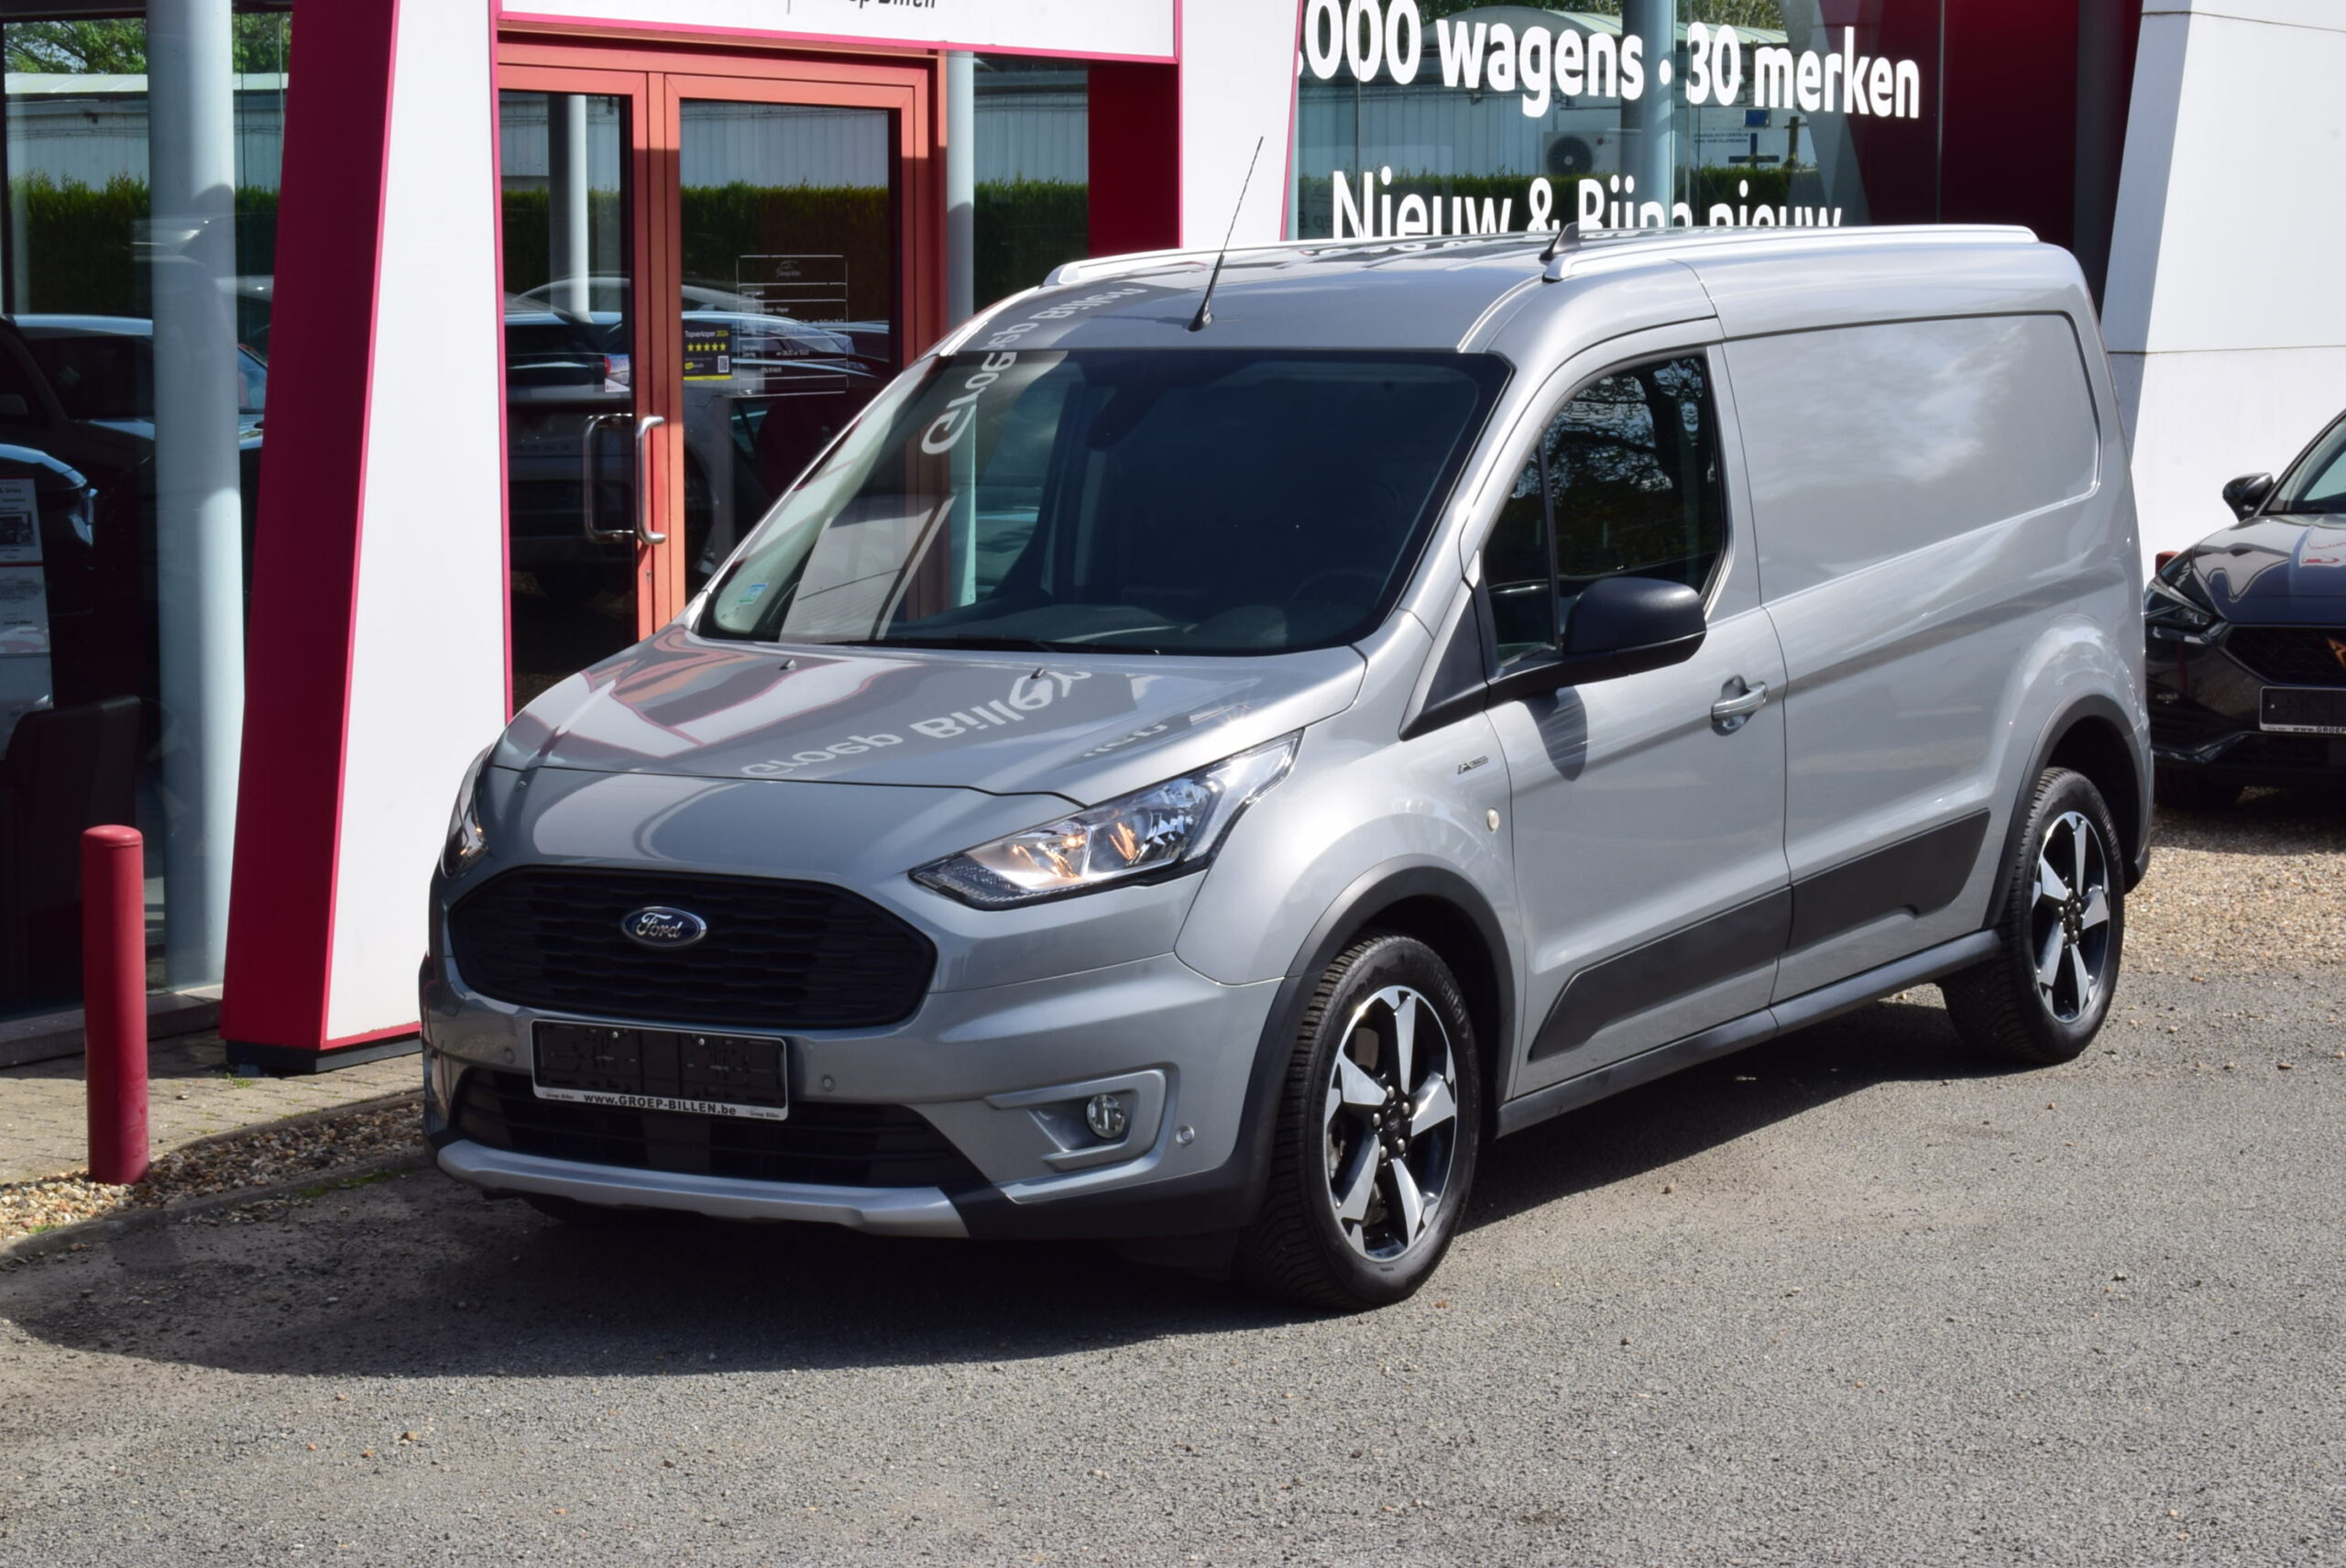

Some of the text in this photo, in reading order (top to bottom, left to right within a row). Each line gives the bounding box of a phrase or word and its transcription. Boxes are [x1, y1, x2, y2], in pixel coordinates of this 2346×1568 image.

[1435, 18, 1645, 118] wagens
[1685, 21, 1741, 106] 30
[1754, 26, 1920, 118] merken
[1332, 165, 1512, 239] Nieuw
[636, 912, 684, 938] Ford
[583, 1092, 737, 1115] www.GROEP-BILLEN.be
